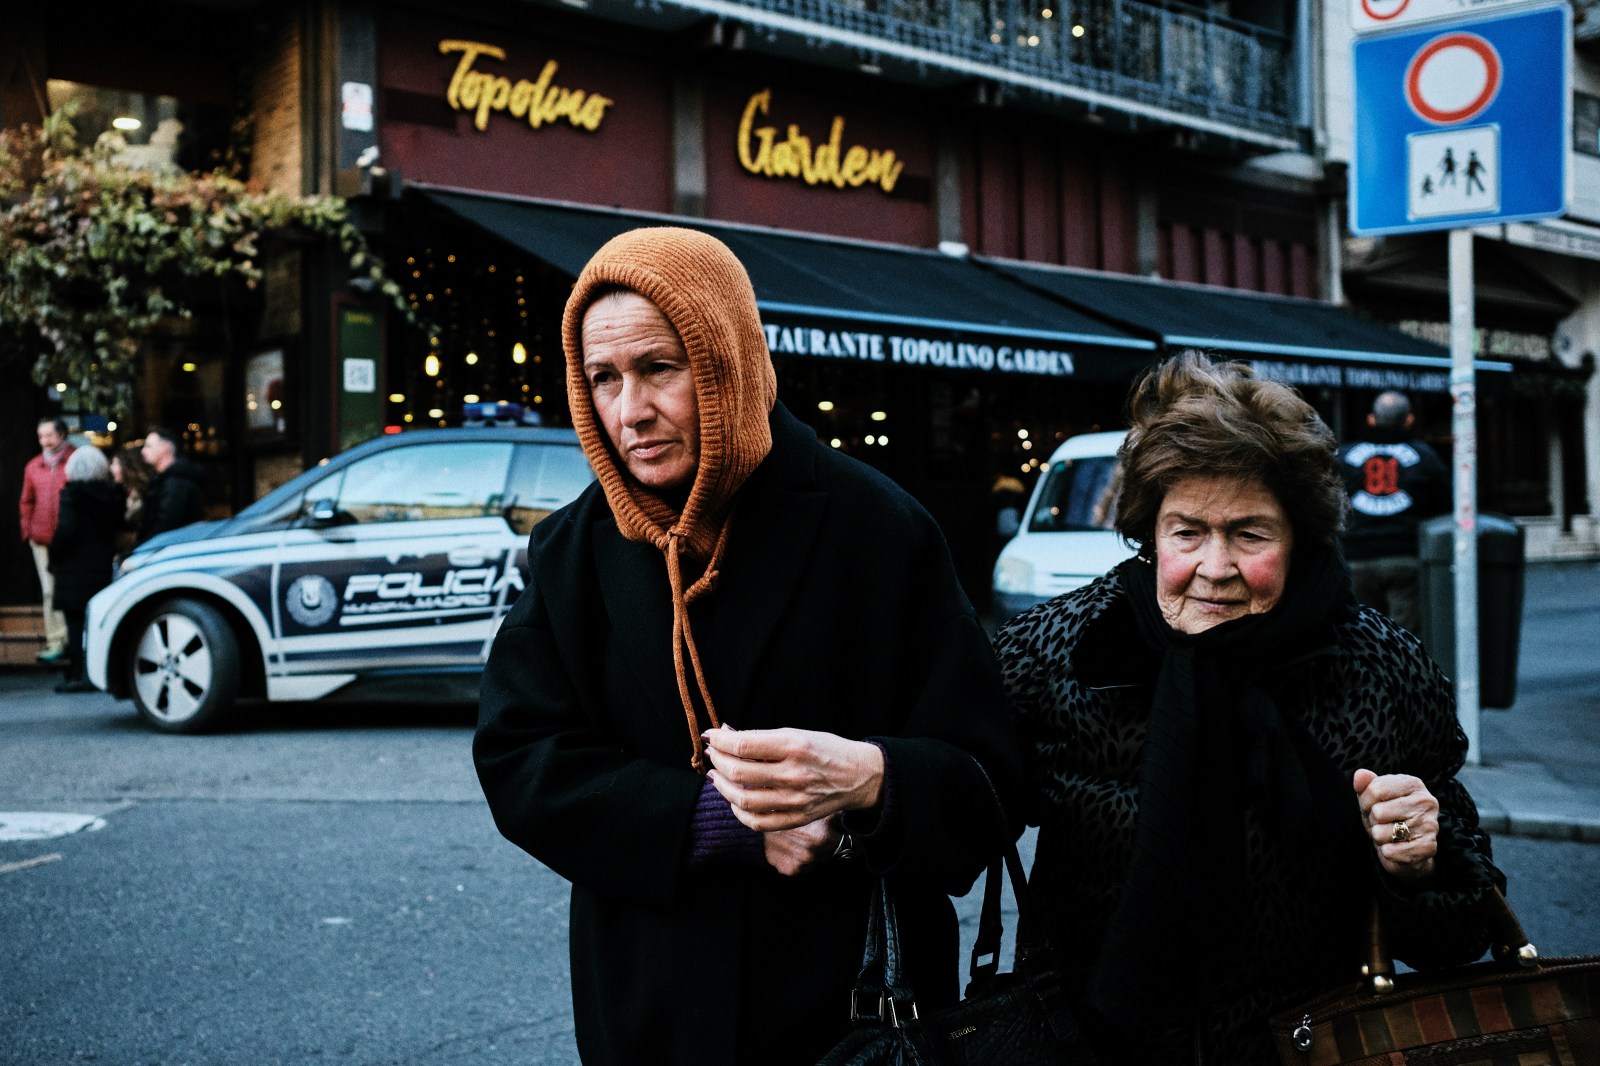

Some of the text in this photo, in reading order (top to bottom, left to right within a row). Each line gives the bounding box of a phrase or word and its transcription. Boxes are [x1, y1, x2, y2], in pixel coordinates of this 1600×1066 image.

[438, 39, 905, 193] Topolino Garden
[763, 324, 1075, 376] TAURANTE TOPOLINO GARDEN
[343, 566, 525, 600] POLICIA
